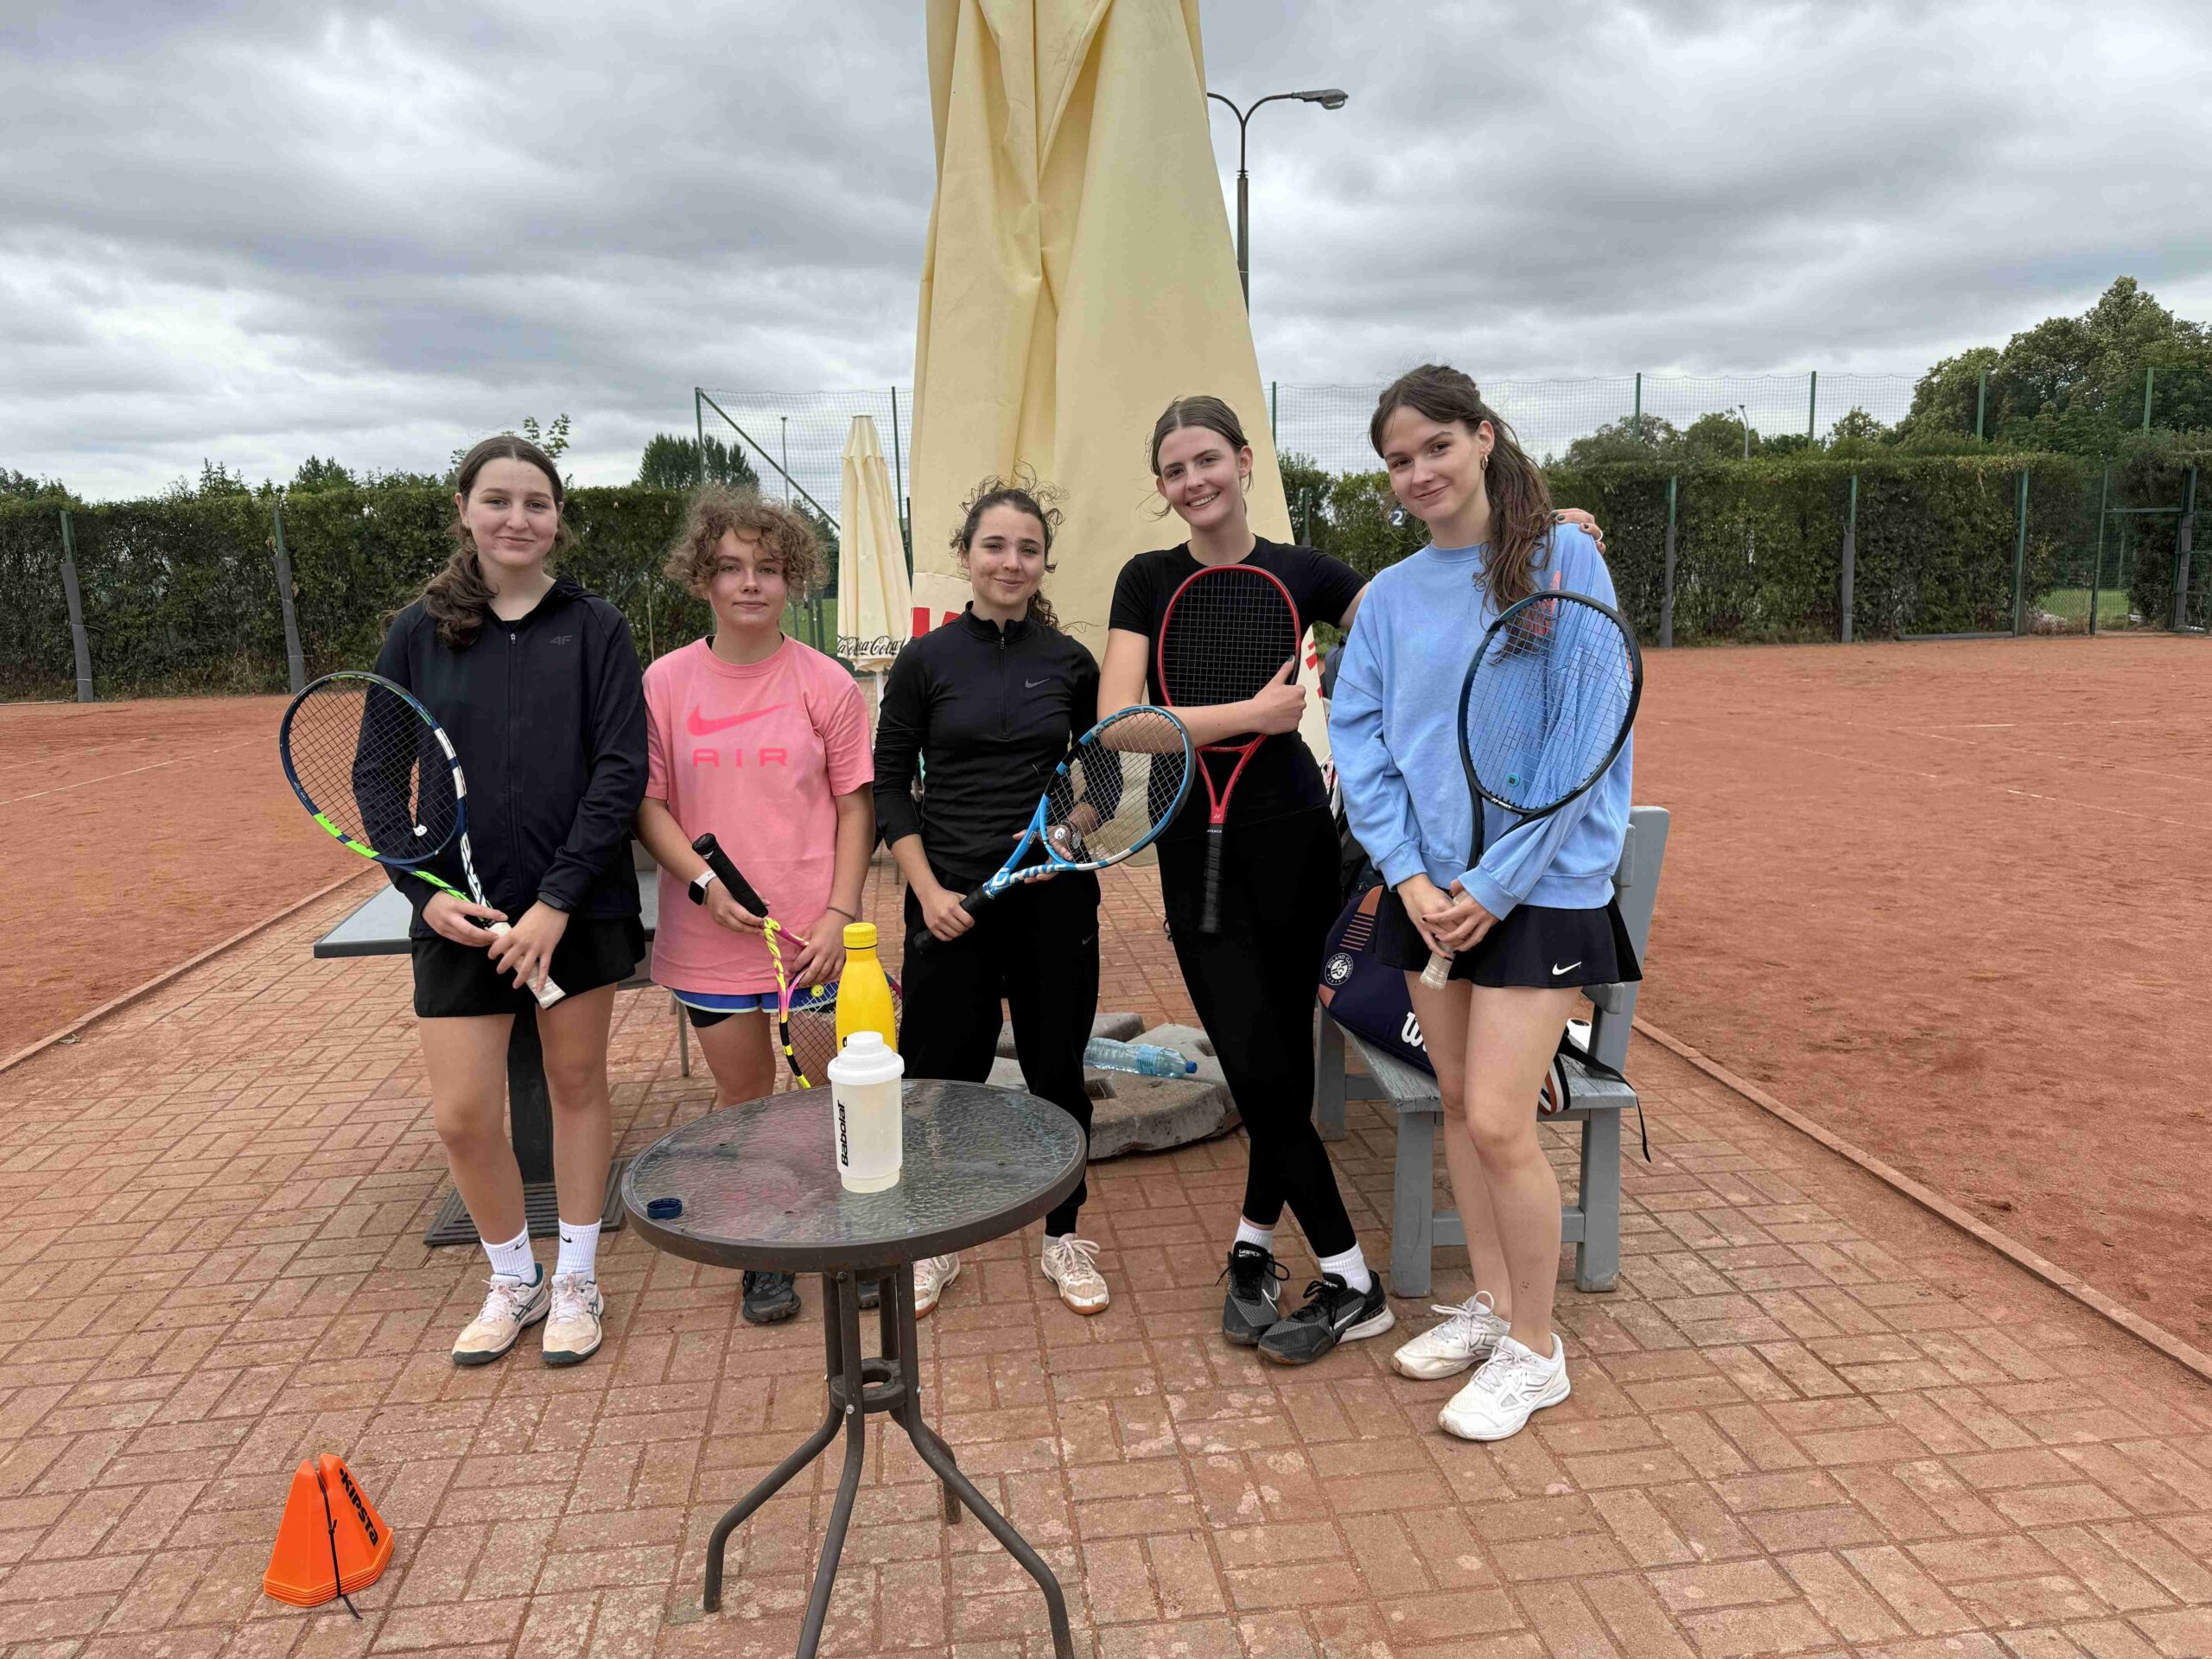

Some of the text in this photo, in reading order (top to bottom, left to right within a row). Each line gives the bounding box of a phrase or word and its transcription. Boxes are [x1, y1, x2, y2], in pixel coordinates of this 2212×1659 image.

[1392, 510, 1403, 526] 2
[549, 635, 573, 645] 4F
[693, 747, 788, 768] AIR
[837, 1099, 849, 1167] Babolat
